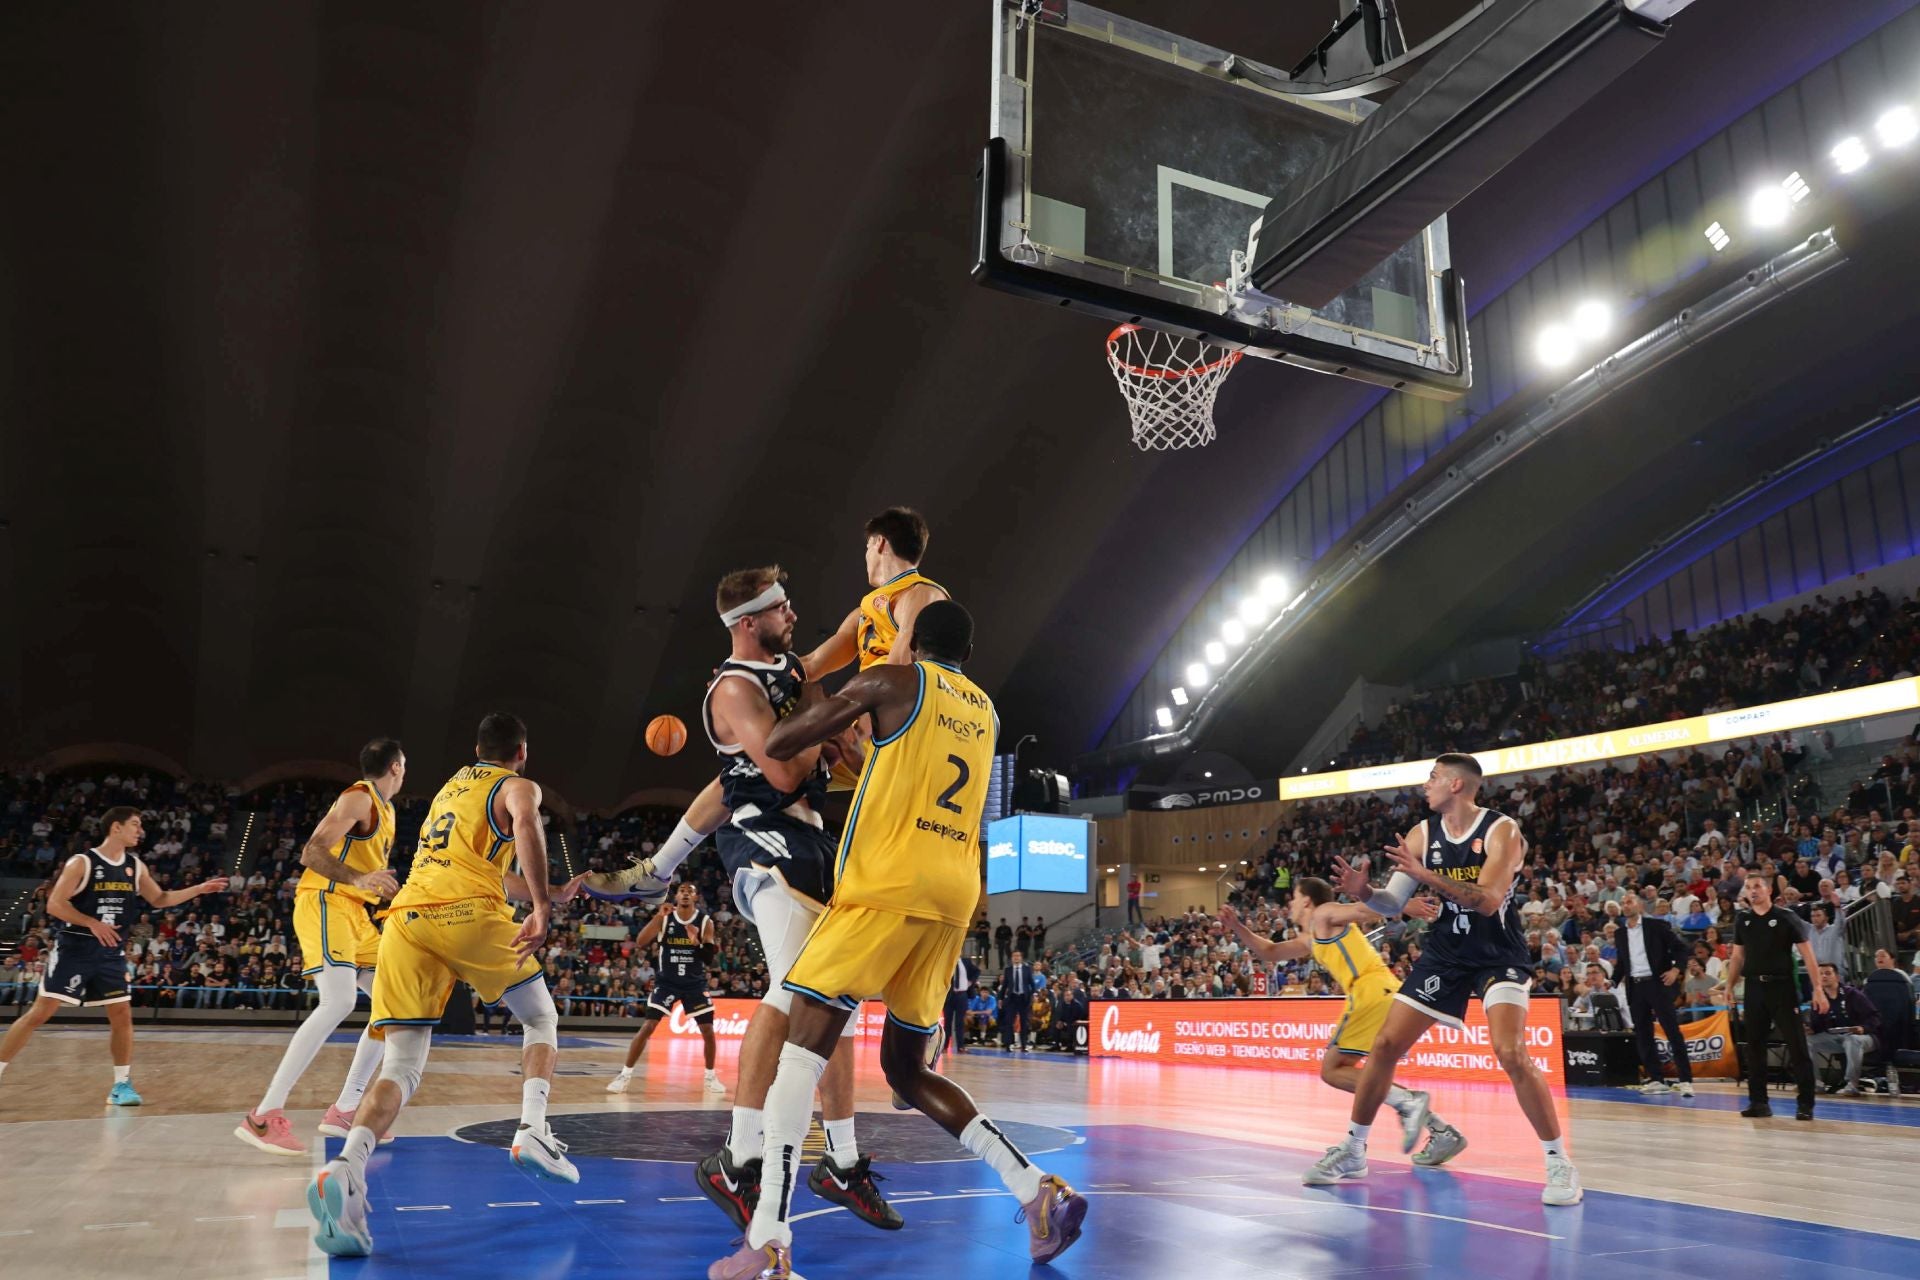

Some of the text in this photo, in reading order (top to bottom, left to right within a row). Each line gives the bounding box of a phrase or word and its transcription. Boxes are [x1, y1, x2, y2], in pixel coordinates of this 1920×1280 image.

[938, 713, 970, 737] MGS
[1628, 727, 1691, 747] ALIMERKA
[1504, 735, 1617, 770] ALIMERKA
[936, 753, 970, 815] 2
[678, 964, 686, 976] 5
[670, 1001, 749, 1035] Craria
[1101, 1005, 1160, 1053] Crearia
[1175, 1021, 1249, 1038] SOLUCIONES
[1251, 1022, 1270, 1038] DE
[1272, 1023, 1337, 1040] COMUNIC
[1438, 1026, 1458, 1044] TU
[1464, 1026, 1553, 1047] NECIO
[1174, 1042, 1205, 1055] DISEÑO
[1205, 1044, 1226, 1056] WEB
[1231, 1045, 1271, 1058] TIENDAS
[1272, 1046, 1310, 1061] ONLINE
[1417, 1053, 1493, 1070] MARKETING
